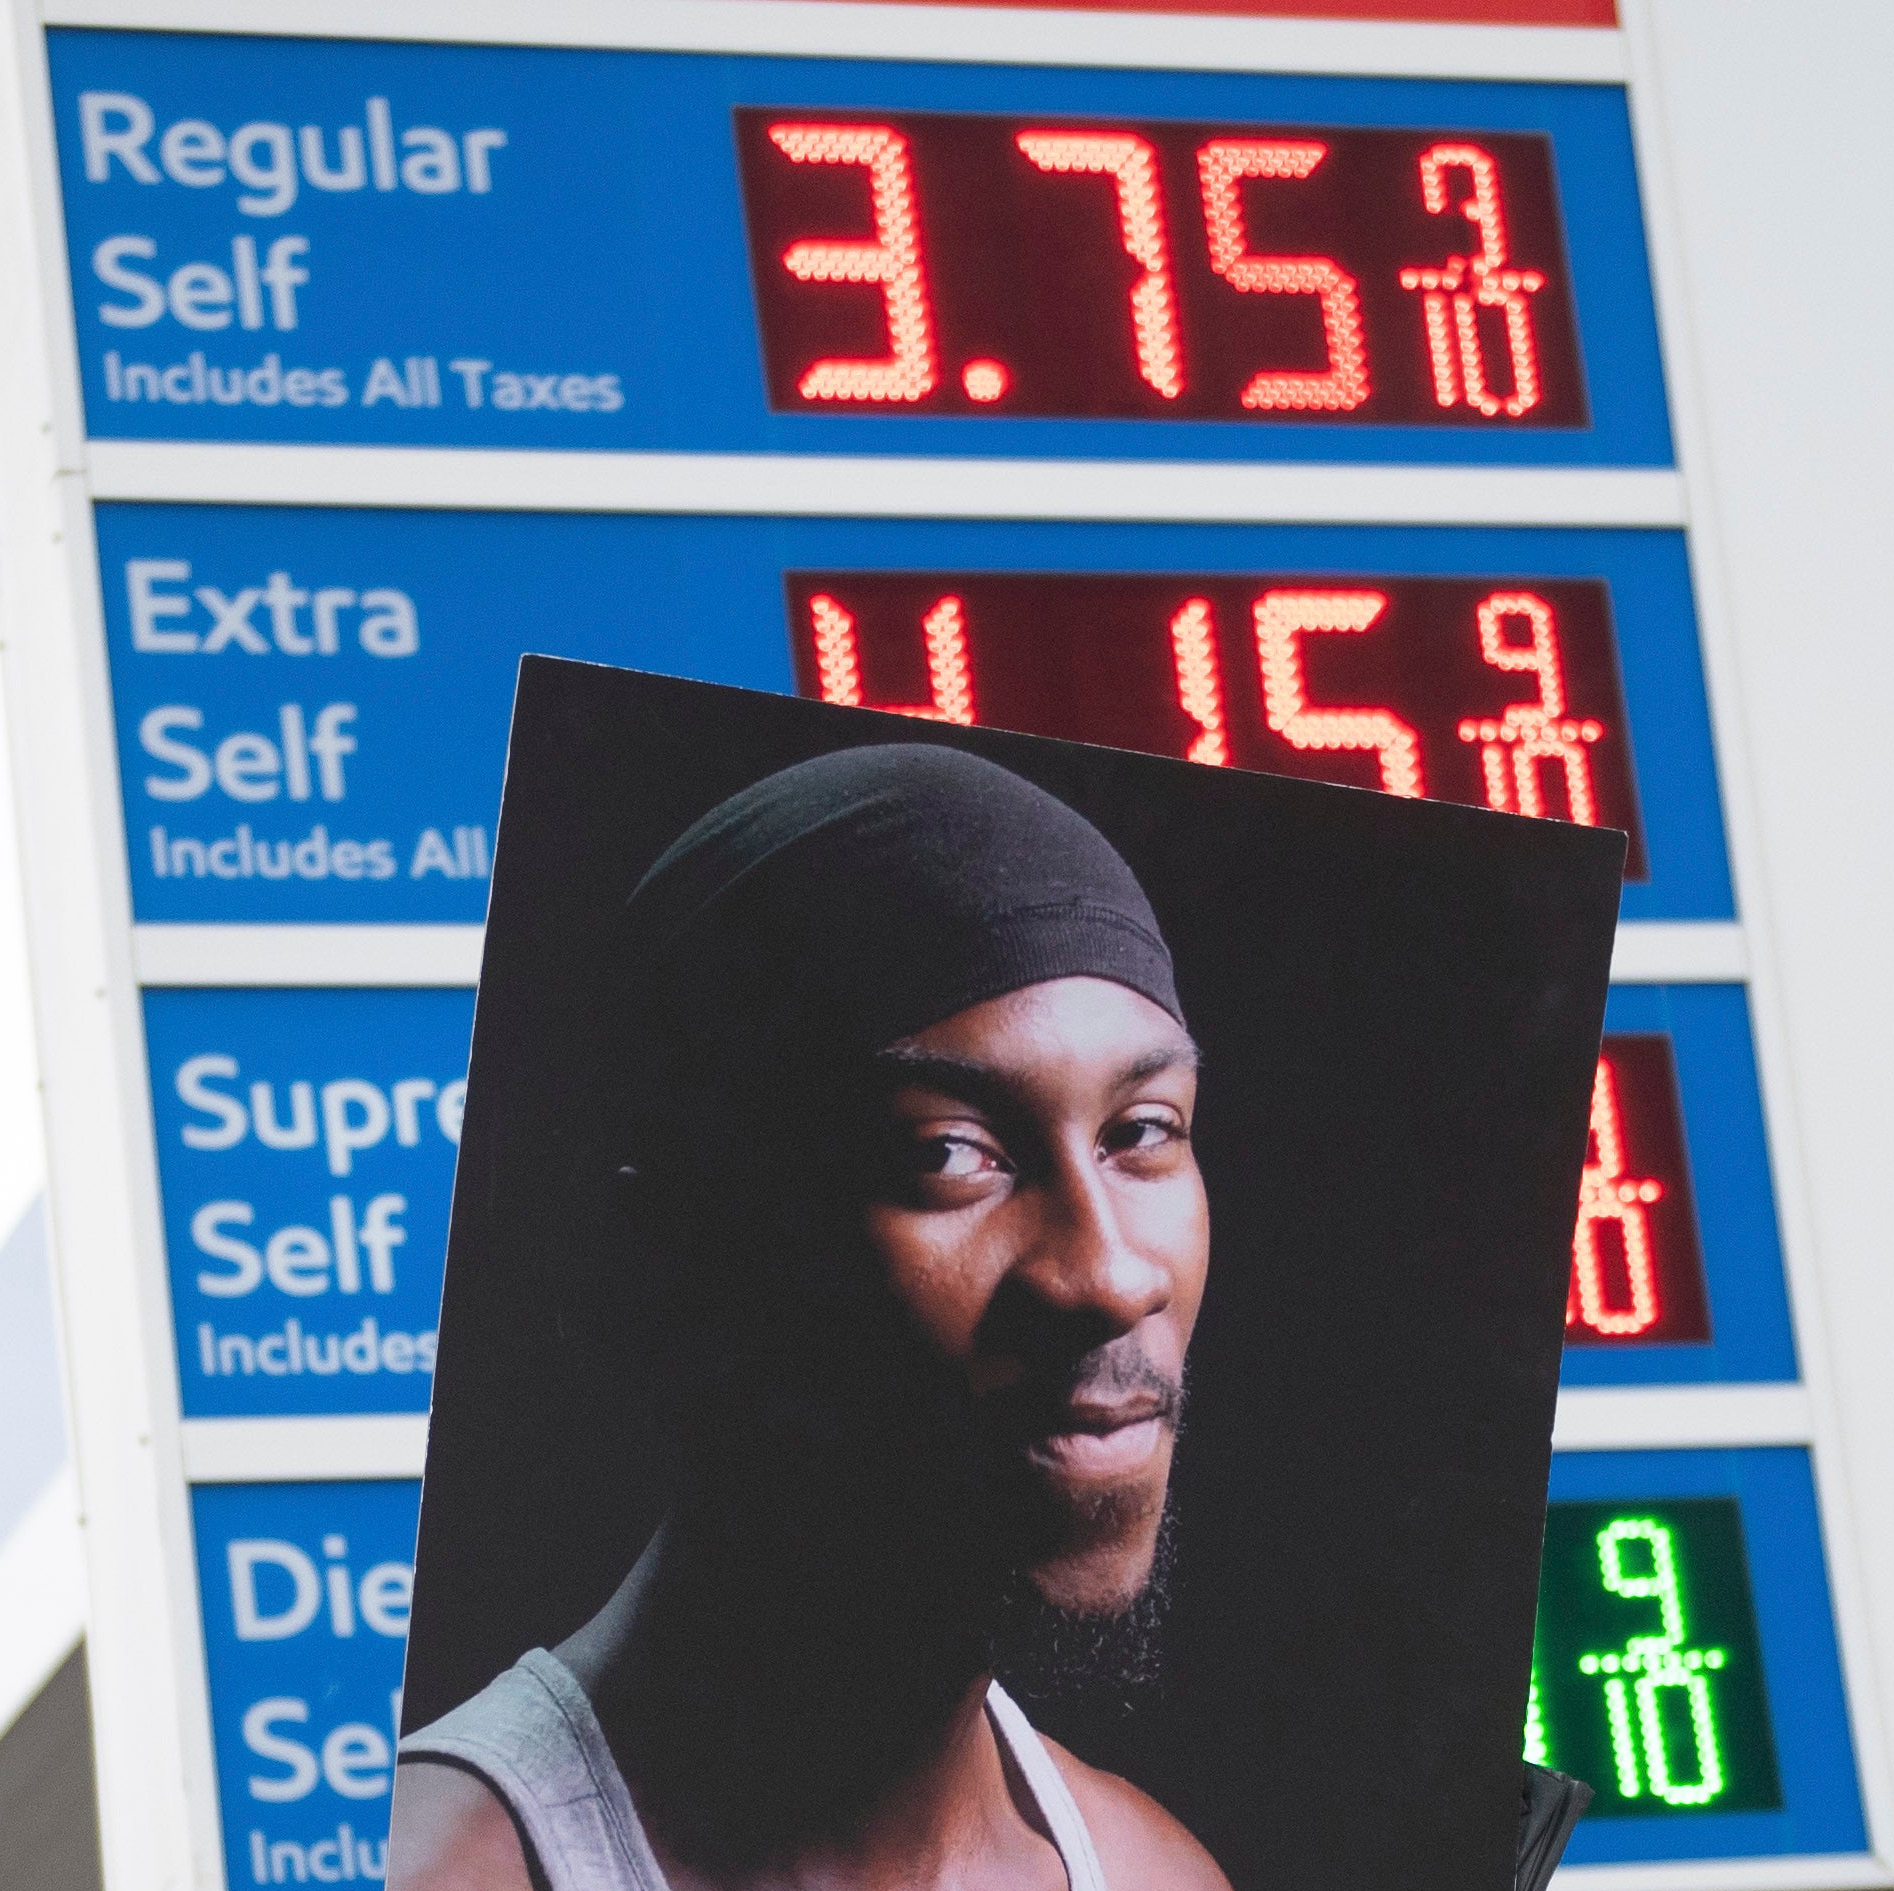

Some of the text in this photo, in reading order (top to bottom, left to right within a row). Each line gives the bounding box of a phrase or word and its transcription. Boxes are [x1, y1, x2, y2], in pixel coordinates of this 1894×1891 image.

[78, 91, 508, 217] Regular
[92, 233, 311, 332] Self
[769, 121, 1369, 410] 3.75
[104, 350, 626, 413] Includes All Taxes
[124, 559, 420, 658] Extra
[138, 702, 359, 802] Self
[149, 824, 490, 879] Includes All
[190, 1192, 408, 1298] Self
[198, 1316, 437, 1377] Includes
[226, 1533, 415, 1642] Die
[241, 1687, 403, 1803] Se
